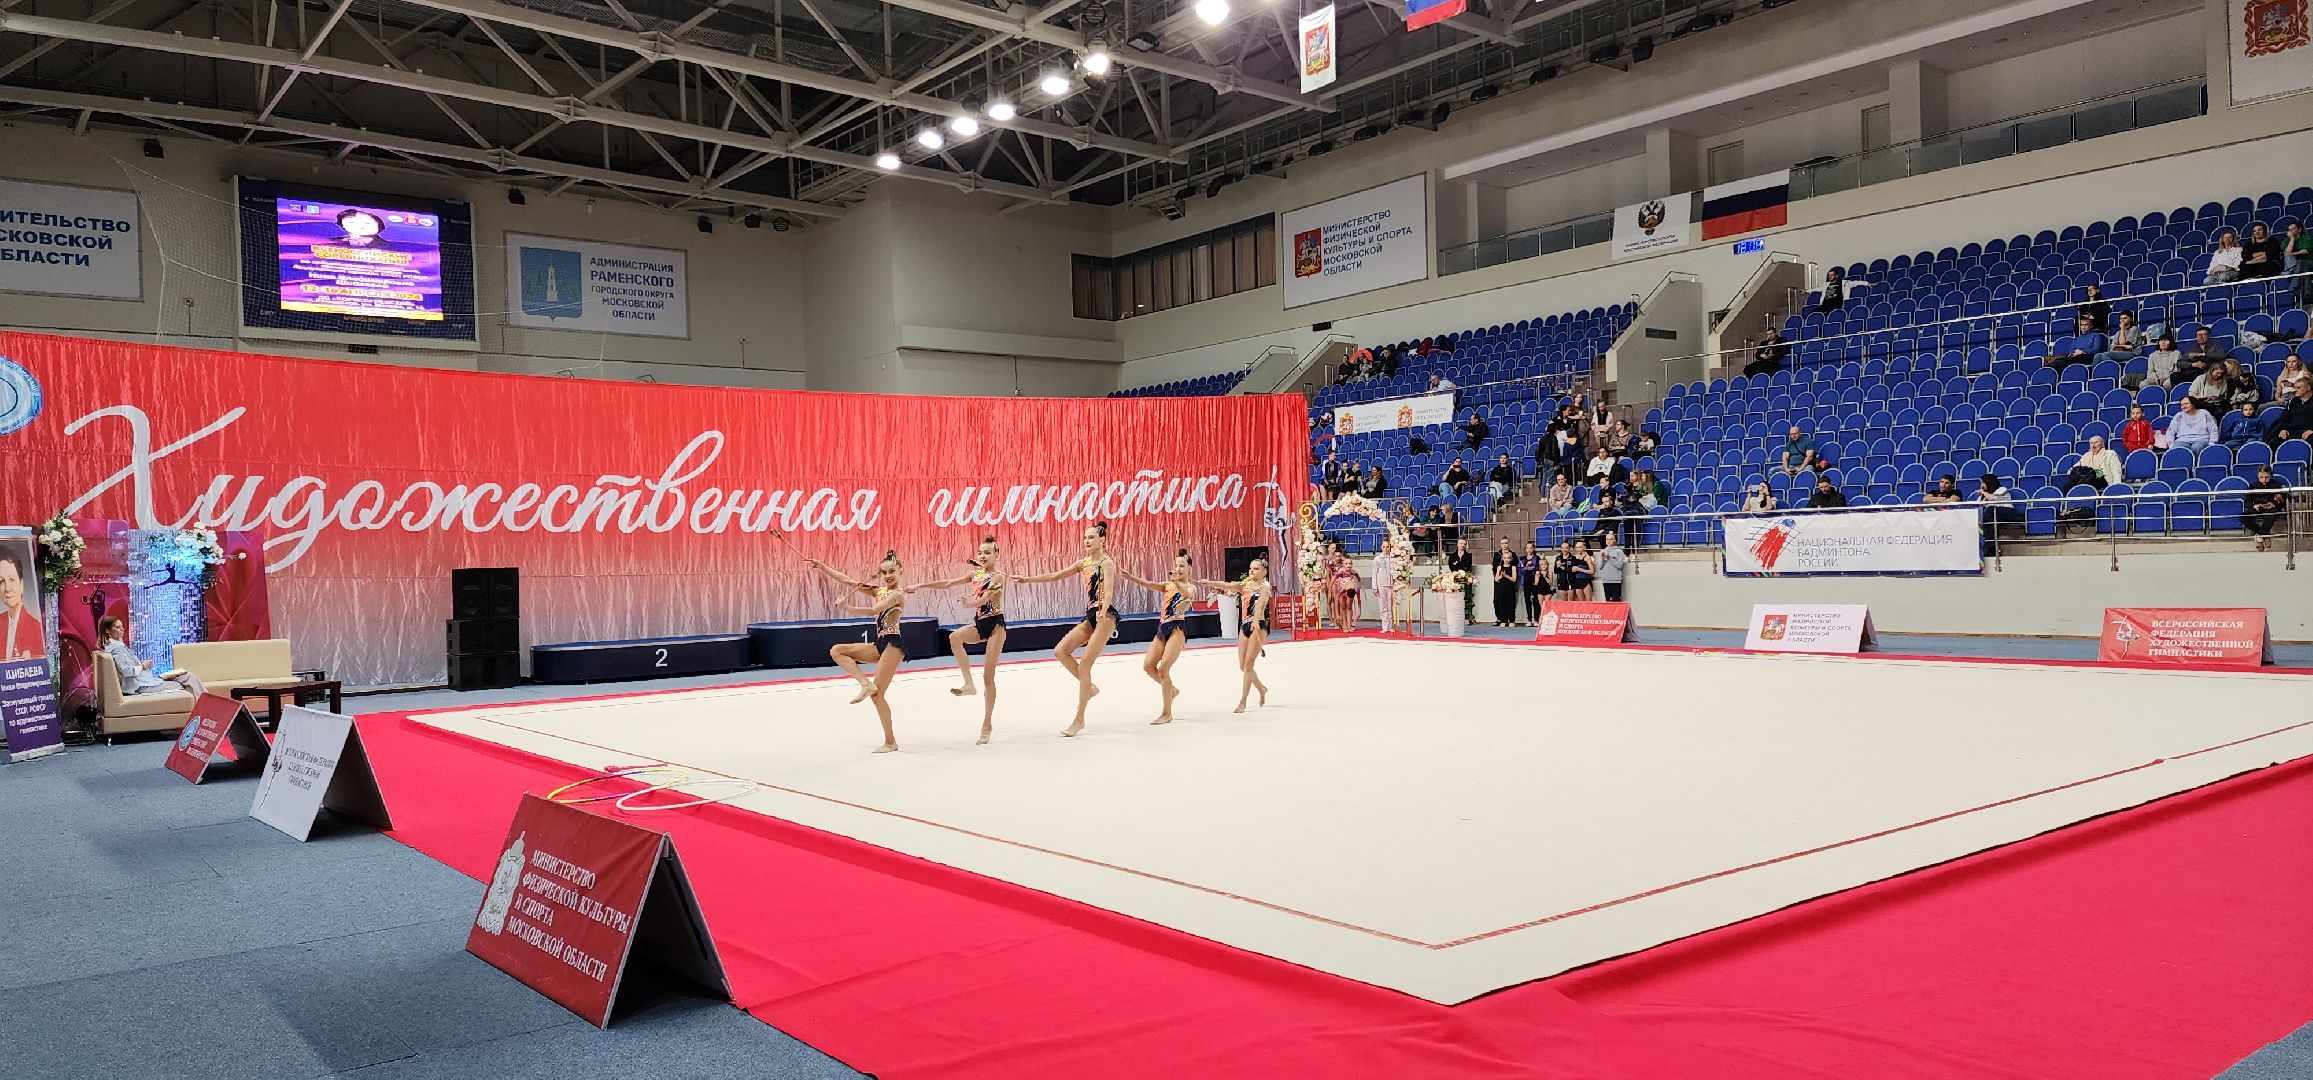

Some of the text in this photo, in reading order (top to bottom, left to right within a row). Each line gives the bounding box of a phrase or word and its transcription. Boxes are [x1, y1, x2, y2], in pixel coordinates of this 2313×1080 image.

[1322, 209, 1391, 235] МИНИСТЕРСТВО
[1322, 222, 1381, 245] ФИЗИЧЕСКОЙ
[1323, 226, 1412, 256] КУЛЬТУРЫ И СПОРТА
[1323, 245, 1383, 266] МОСКОВСКОЙ
[590, 257, 673, 273] АДМИНИСТРАЦИЯ
[1323, 260, 1362, 277] ОБЛАСТИ
[590, 270, 674, 288] РАМЕНСКОГО
[591, 285, 674, 299] ГОРОДСКОГО ОКРУГА
[602, 297, 664, 310] МОСКОВСКОЙ
[612, 309, 655, 321] ОБЛАСТИ
[928, 469, 1248, 528] гимнастика
[1797, 533, 1953, 548] НАЦИОНАЛЬНАЯ ФЕДЕРАЦИЯ
[1798, 548, 1870, 558] БАДМИНТОНА
[1798, 558, 1839, 568] РОССИИ
[2152, 620, 2244, 629] ВСЕРОССИЙСКАЯ
[861, 630, 868, 643] 1
[2150, 629, 2216, 638] ФЕДЕРАЦИЯ
[2149, 639, 2254, 649] ХУДОЖЕСТВЕННОЙ
[655, 648, 668, 667] 2
[2148, 648, 2223, 658] ГИМНАСТИКИ
[530, 849, 596, 890] МИНИСТЕРСТВО
[514, 893, 553, 926] И СПОРТА
[522, 872, 631, 934] ФИЗИЧЕСКОЙ КУЛЬТУРЫ
[505, 915, 608, 982] МОСКОВСКОЙ ОБЛАСТИ
